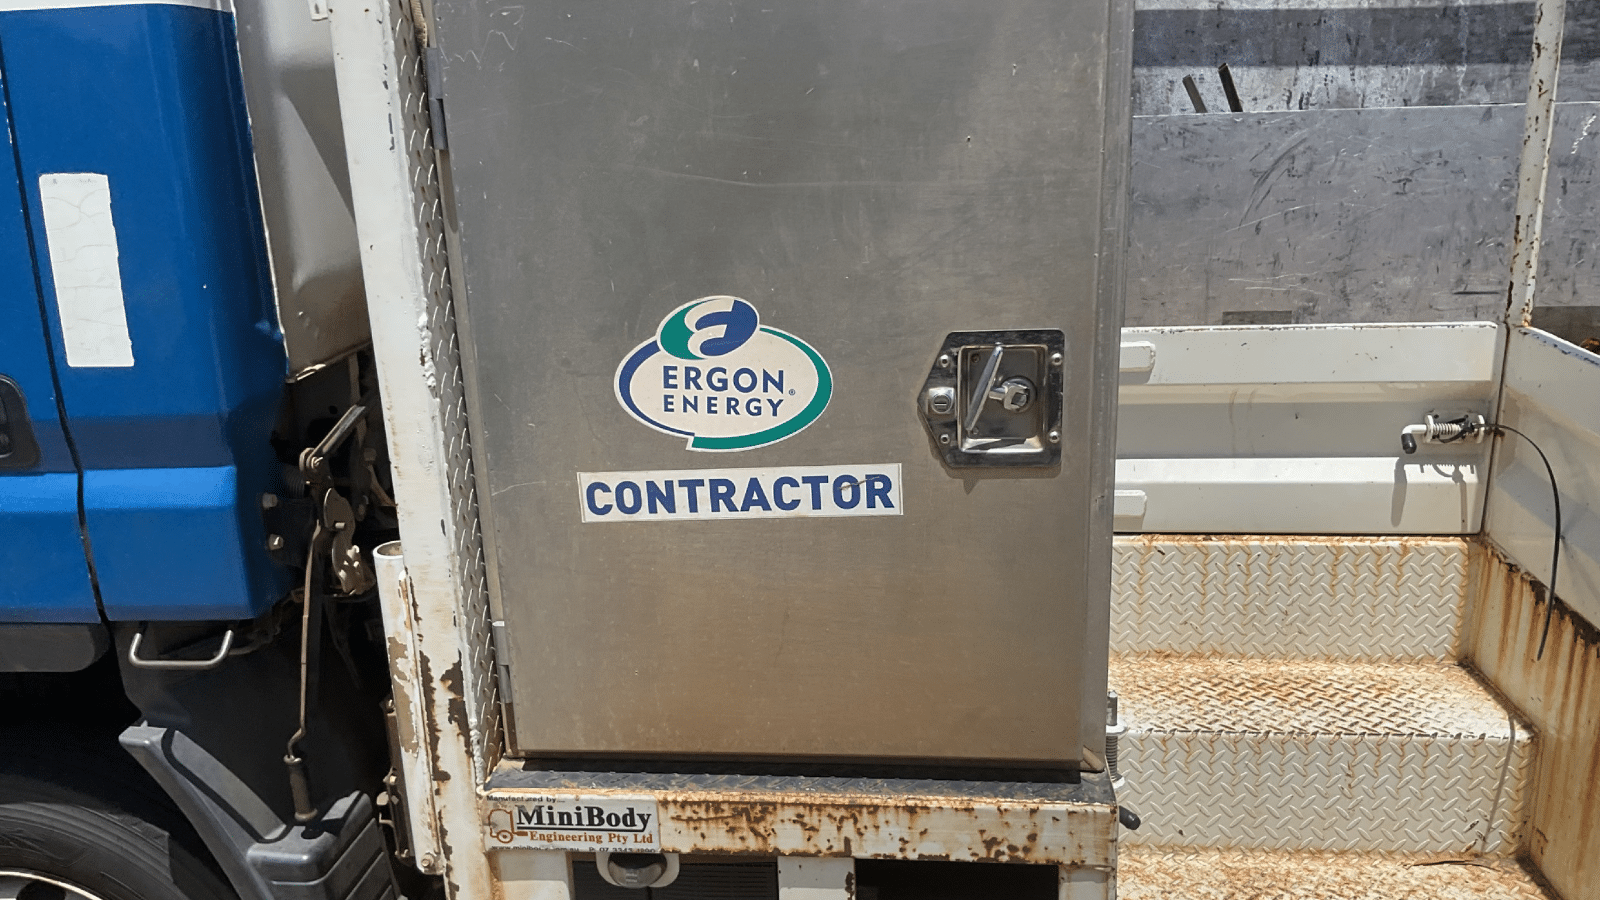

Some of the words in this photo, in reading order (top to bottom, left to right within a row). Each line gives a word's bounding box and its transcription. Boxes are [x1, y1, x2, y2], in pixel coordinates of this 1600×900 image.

[662, 365, 785, 394] ERGON
[663, 394, 785, 417] ENERGY
[585, 473, 895, 516] CONTRACTOR
[515, 804, 652, 832] MiniBody
[529, 830, 603, 844] Engineering
[608, 832, 628, 845] Pty
[633, 833, 653, 844] Ltd
